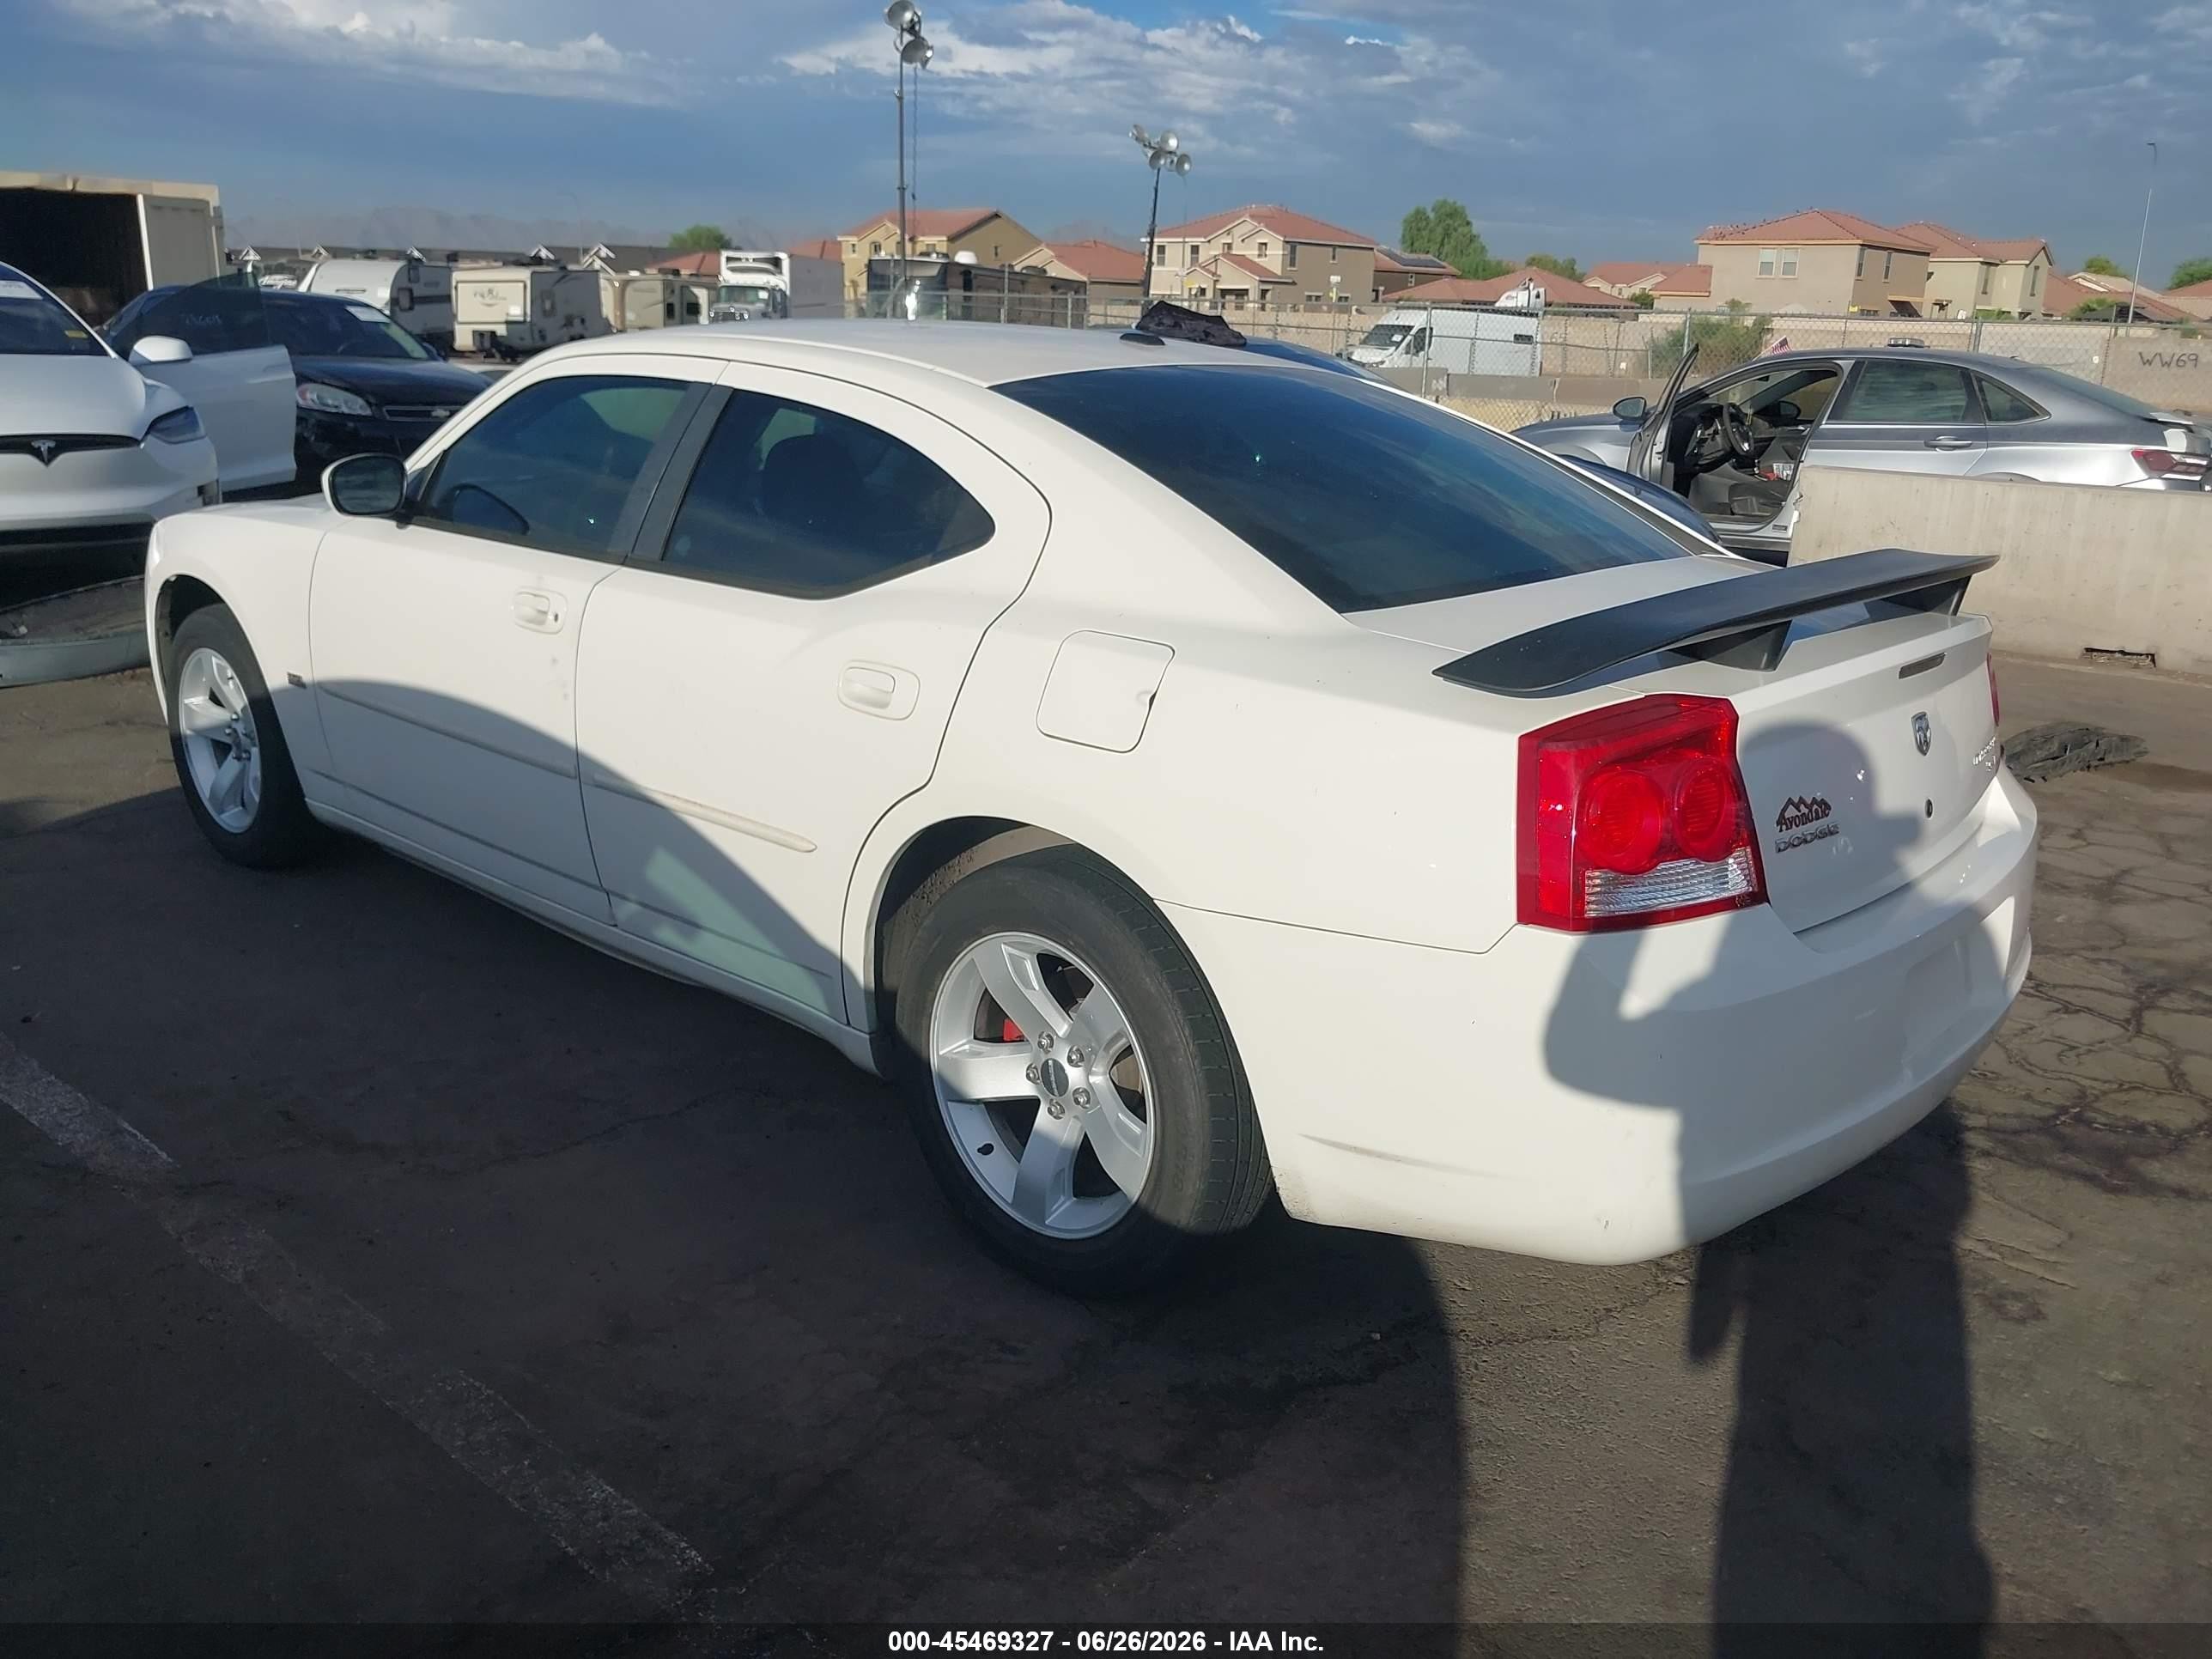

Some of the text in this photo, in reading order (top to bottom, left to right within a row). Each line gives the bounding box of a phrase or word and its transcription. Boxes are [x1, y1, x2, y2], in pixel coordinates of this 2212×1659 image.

[2138, 351, 2199, 368] WW69
[1776, 799, 1832, 833] Avondale
[1775, 822, 1839, 854] DODGE
